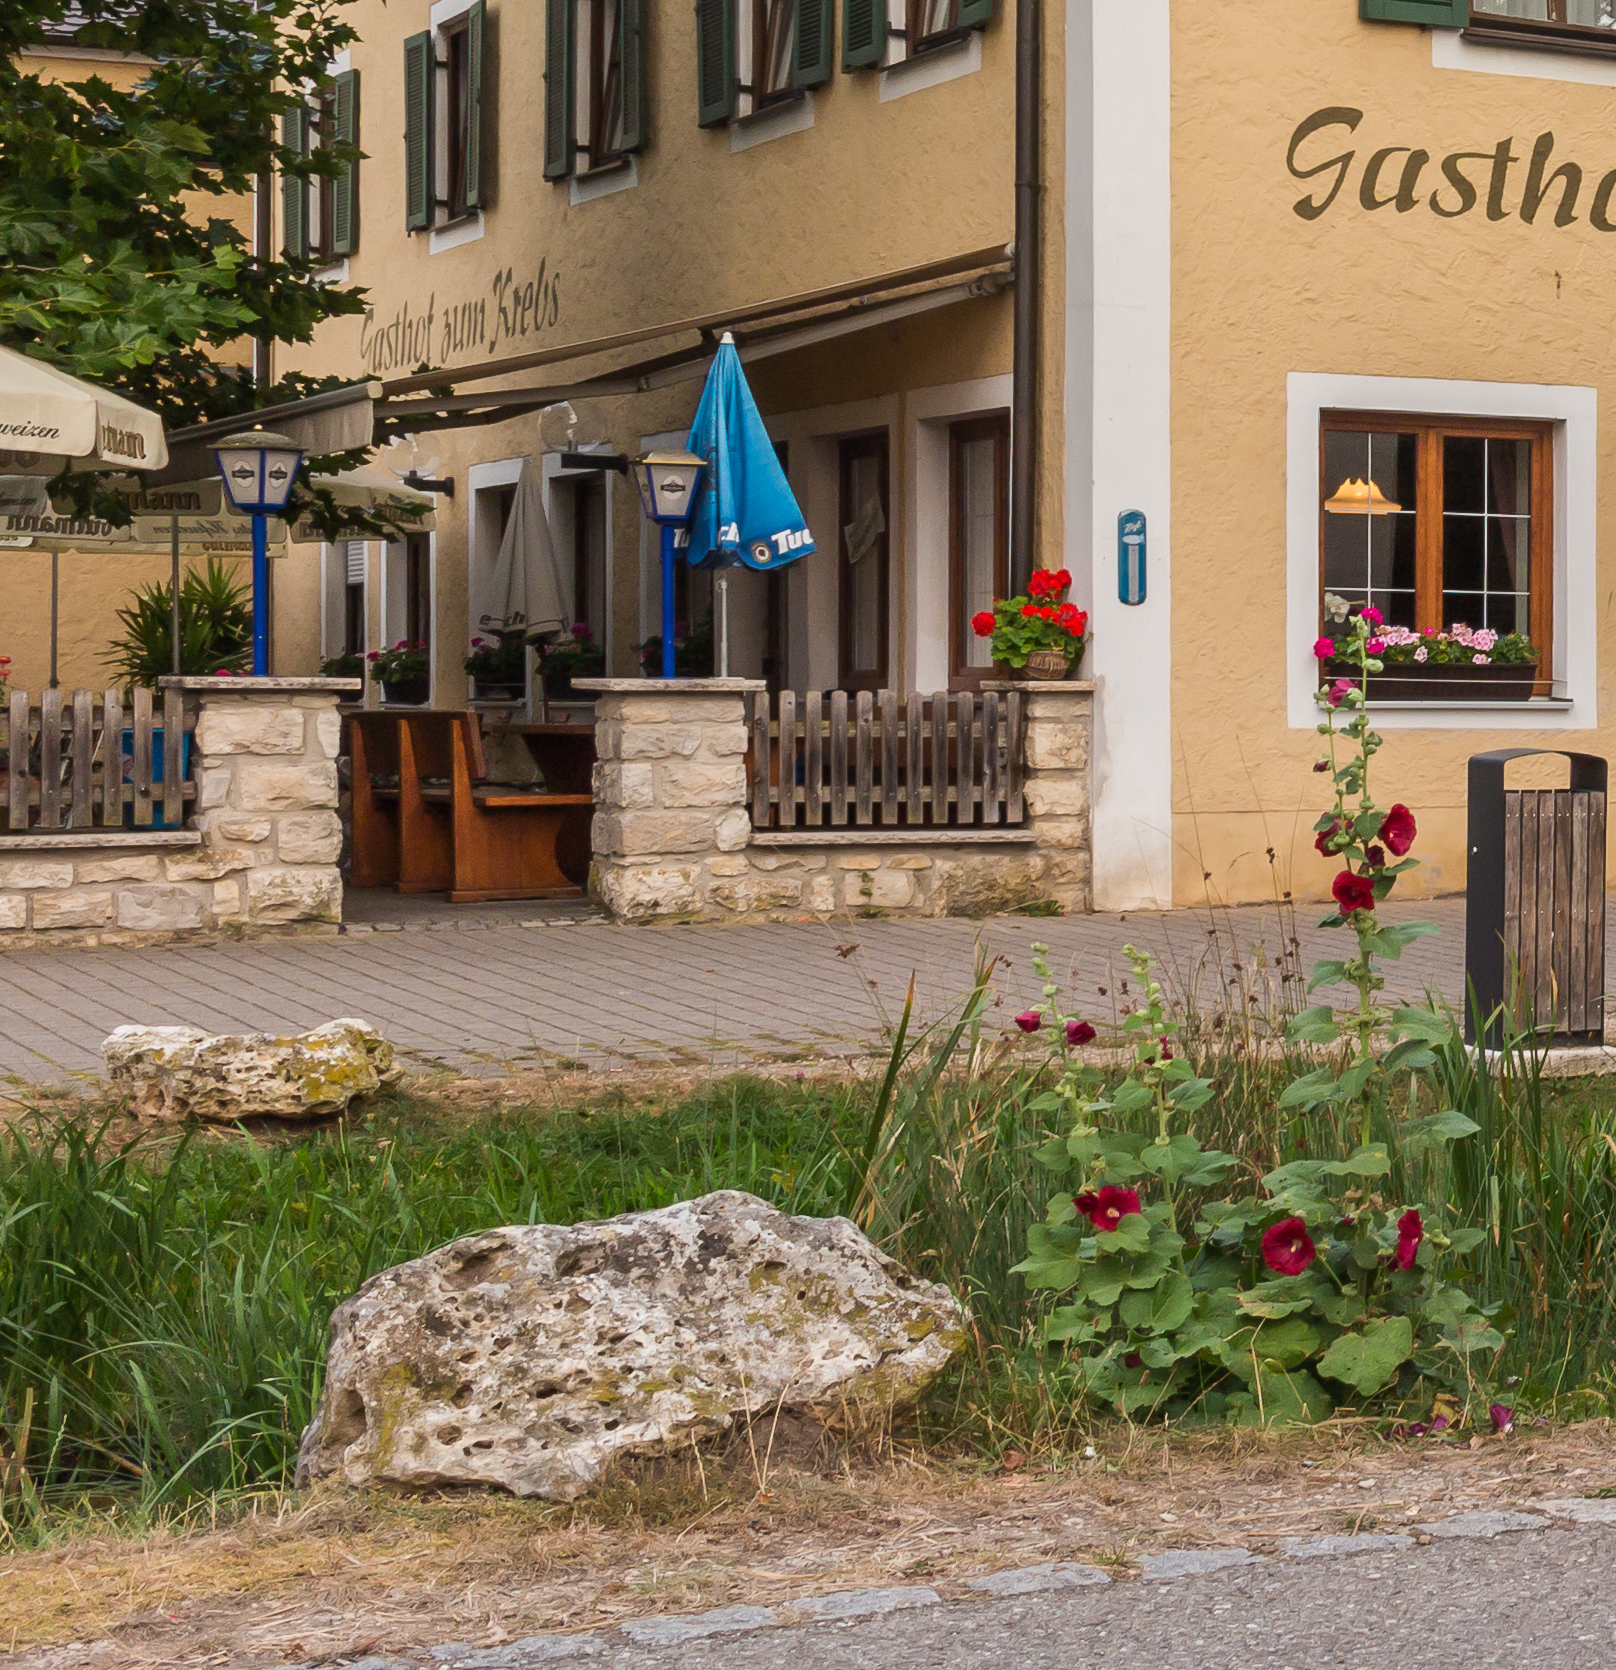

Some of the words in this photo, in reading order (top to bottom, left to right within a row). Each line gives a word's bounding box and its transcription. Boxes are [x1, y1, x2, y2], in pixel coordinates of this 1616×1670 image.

[360, 291, 435, 374] Gasthof
[441, 297, 485, 364] zum
[489, 256, 560, 355] Krebs
